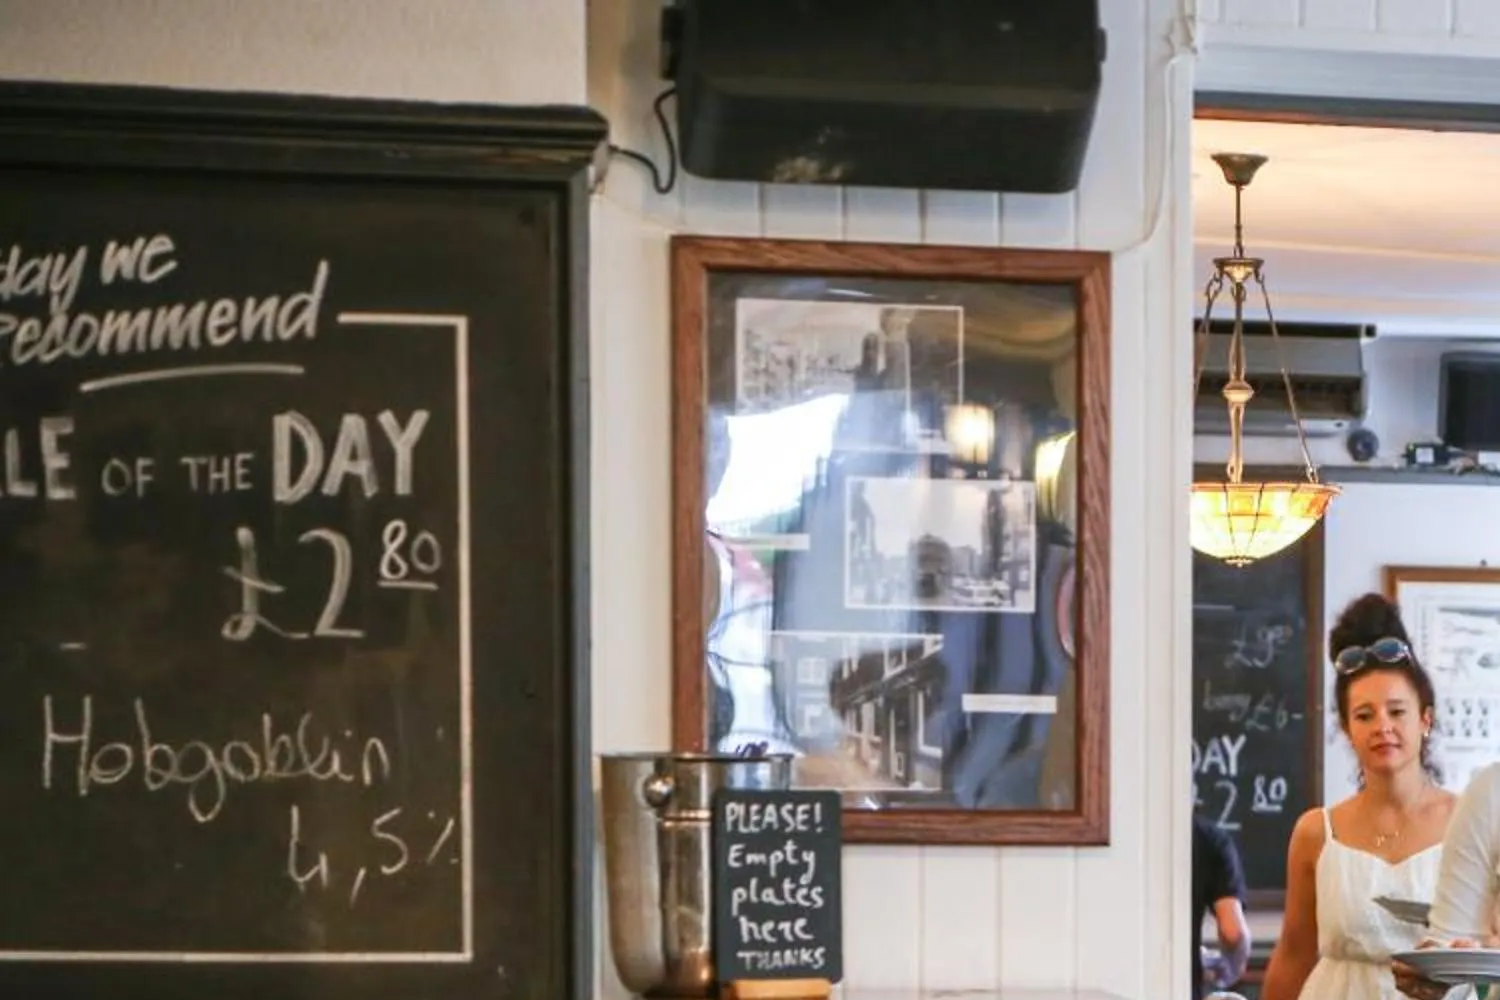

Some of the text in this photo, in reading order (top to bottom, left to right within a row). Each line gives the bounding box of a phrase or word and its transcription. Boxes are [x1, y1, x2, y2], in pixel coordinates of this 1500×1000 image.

[100, 234, 178, 285] we
[0, 409, 430, 503] LE OF THE DAY
[43, 694, 391, 823] Hobgoblin
[724, 801, 823, 834] PLEASE!
[728, 839, 816, 885] Empty
[731, 877, 825, 916] plates
[738, 915, 815, 943] here
[736, 947, 826, 970] THANKS
